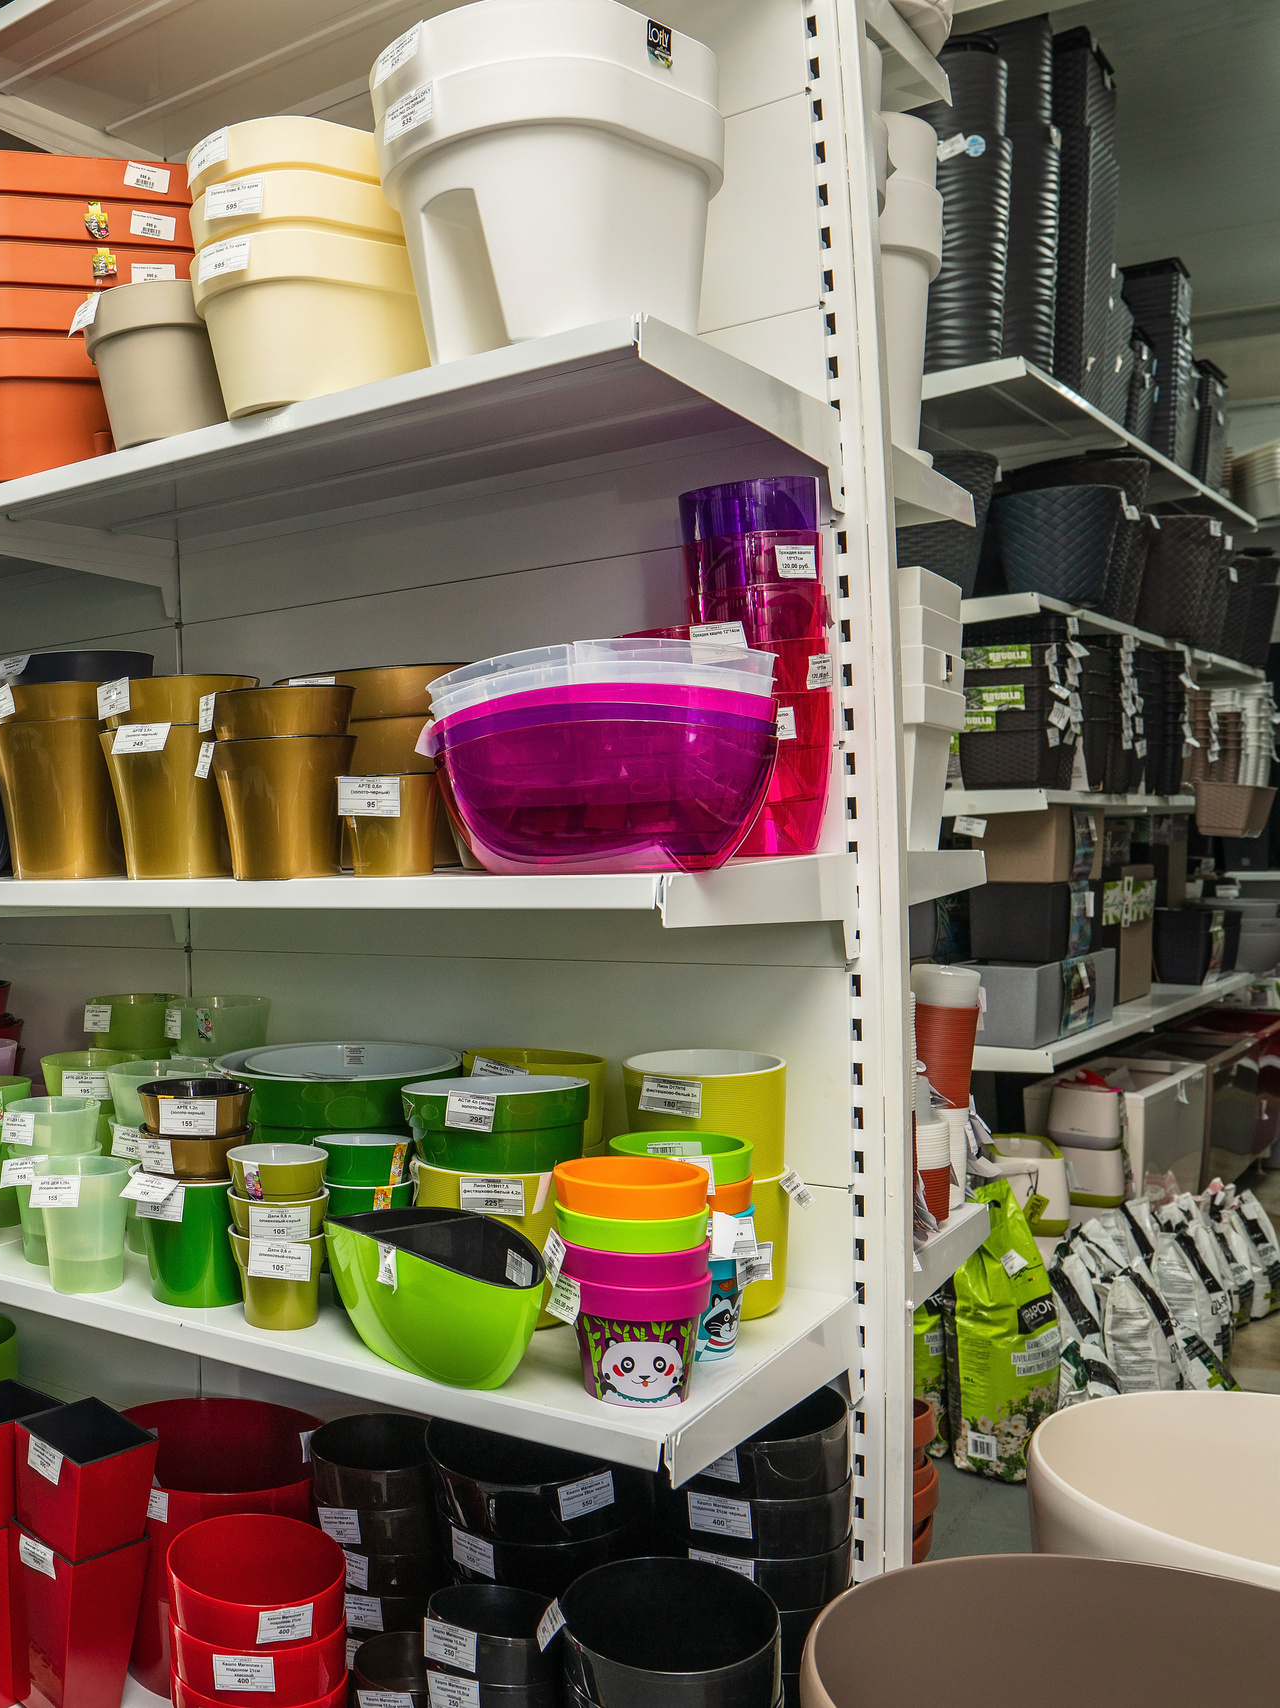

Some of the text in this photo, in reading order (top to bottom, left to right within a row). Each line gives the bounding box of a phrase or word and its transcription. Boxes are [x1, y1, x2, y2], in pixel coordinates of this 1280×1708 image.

[402, 116, 412, 127] 535
[214, 261, 225, 270] 595
[581, 1482, 600, 1491] Магнолия
[713, 1502, 736, 1510] Магнолия
[446, 1631, 465, 1641] Магнолия
[444, 1648, 454, 1657] 250
[448, 1682, 466, 1690] Магнолия
